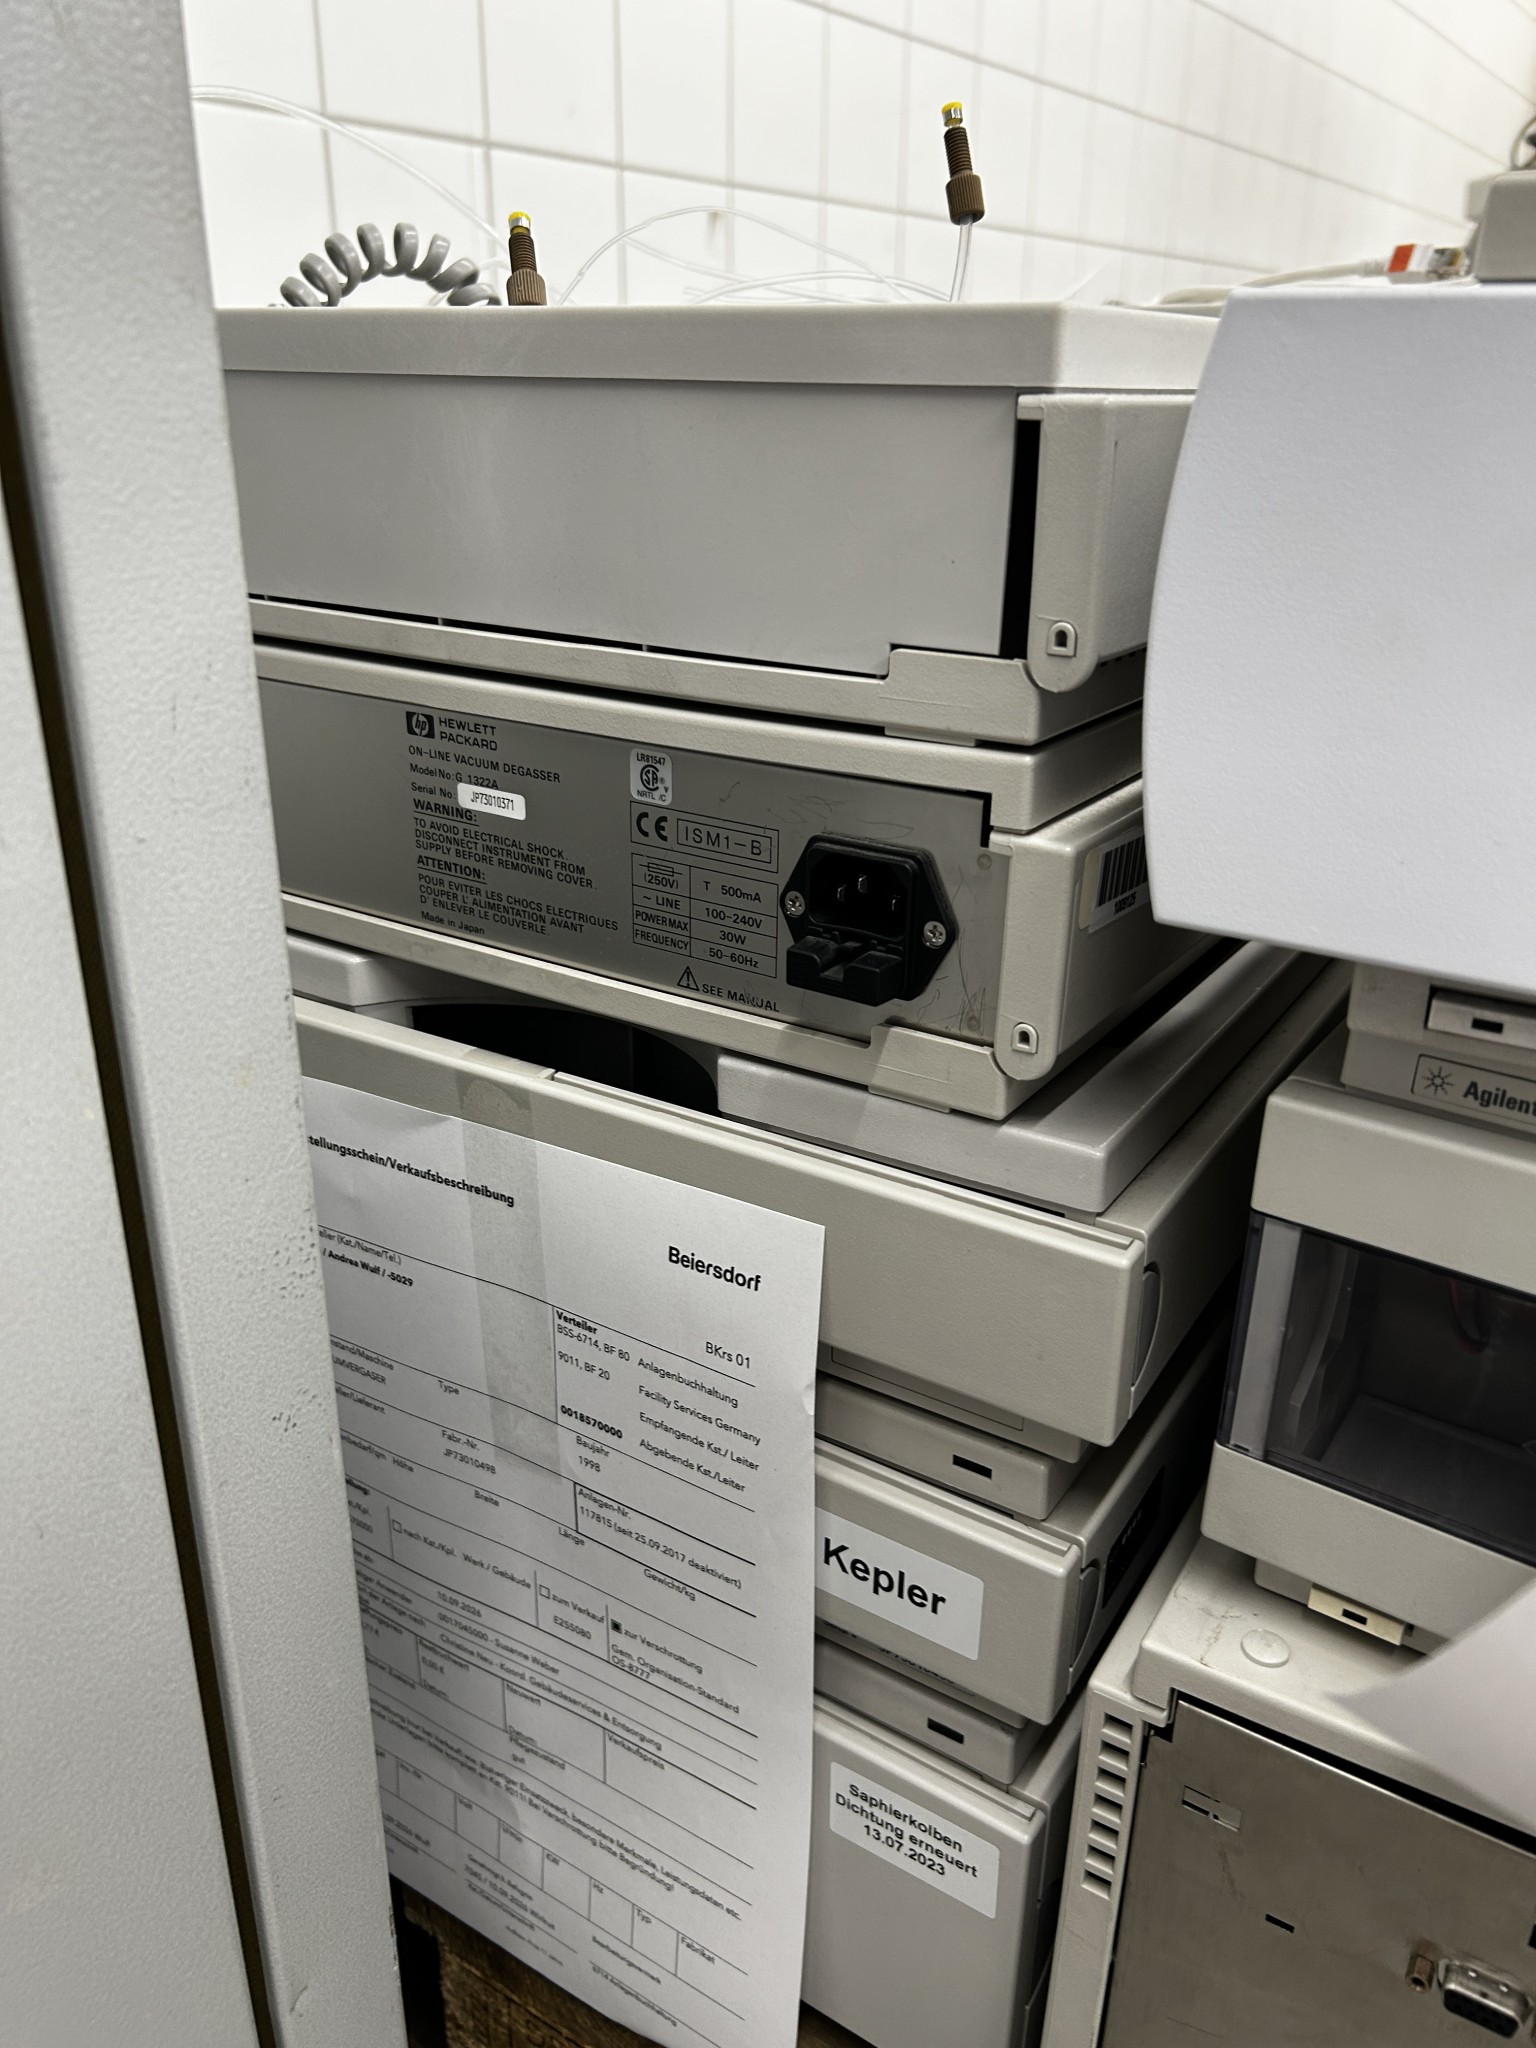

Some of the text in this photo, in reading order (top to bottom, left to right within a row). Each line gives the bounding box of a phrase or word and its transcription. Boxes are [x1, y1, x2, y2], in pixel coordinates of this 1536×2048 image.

[438, 716, 497, 737] HEWLETT
[439, 731, 498, 751] PACKARD
[408, 745, 561, 784] ON-LINE VACUUM DEGASSER
[636, 753, 666, 766] LR81547
[409, 762, 437, 777] Model
[467, 774, 499, 790] 1322A
[411, 781, 457, 799] Serial No:
[413, 798, 477, 822] WARNING:
[470, 791, 515, 811] JP73010371
[413, 817, 427, 829] TO
[429, 820, 460, 836] AVOID
[463, 827, 523, 850] ELECTRICAL
[636, 811, 668, 841] CE
[415, 829, 586, 876] DISCONNECT INSTRUMENT FROM
[684, 826, 762, 856] ISM1-B
[415, 839, 451, 856] SUPPLY
[455, 848, 495, 867] BEFORE
[497, 858, 554, 880] REMOVING
[417, 855, 486, 881] ATTENTION:
[644, 872, 679, 890] (250V)
[703, 881, 762, 903] T 500mA
[418, 873, 619, 931] POUR EVITER LES CHOCS ELECTRIQUES
[419, 885, 459, 902] COUPER
[472, 897, 547, 924] ALIMENTATION
[549, 916, 584, 934] AVANT
[432, 898, 476, 917] ENLEVER
[478, 908, 490, 919] LE
[656, 895, 681, 911] LINE
[421, 910, 485, 936] Made in Japan
[635, 909, 689, 933] POWER MAX
[704, 907, 763, 929] 100-240V
[635, 929, 689, 951] FREQUENCY
[719, 930, 747, 946] 30W
[708, 947, 759, 969] 50-60Hz
[702, 982, 780, 1013] SEE MANUAL
[308, 1134, 515, 1208] tellungsschein/Verkaufsbeschreibung
[328, 1250, 359, 1267] Andrea
[360, 1259, 381, 1275] Wulf
[387, 1271, 413, 1287] -5029
[668, 1245, 762, 1291] Beiersdorf
[556, 1310, 597, 1334] Verteiler
[603, 1342, 617, 1356] BF
[618, 1349, 630, 1362] 80
[705, 1341, 751, 1369] BKrs 01
[584, 1362, 598, 1375] BF
[599, 1368, 611, 1381] 20
[637, 1358, 739, 1409] Anlagenbuchhaltung
[437, 1379, 460, 1395] Type
[560, 1405, 623, 1439] 0018570000
[638, 1385, 761, 1446] Facility Services Germany
[575, 1435, 610, 1458] Baujahr
[639, 1412, 705, 1448] Empfangende
[730, 1451, 760, 1471] Leiter
[639, 1438, 695, 1470] Abgebende
[578, 1456, 601, 1472] 1998
[558, 1526, 586, 1547] Länge
[613, 1522, 634, 1539] (seit
[634, 1532, 686, 1563] 25.09.2017
[688, 1558, 742, 1589] deaktiviert)
[643, 1568, 696, 1601] Gewicht/kg
[823, 1536, 947, 1616] Kepler
[571, 1600, 605, 1624] Verkauf
[623, 1629, 703, 1675] zur Verschrottung
[848, 1782, 963, 1853] Saphierkolben
[834, 1793, 979, 1879] Dichtung erneuert
[863, 1824, 947, 1878] 13.07.2023
